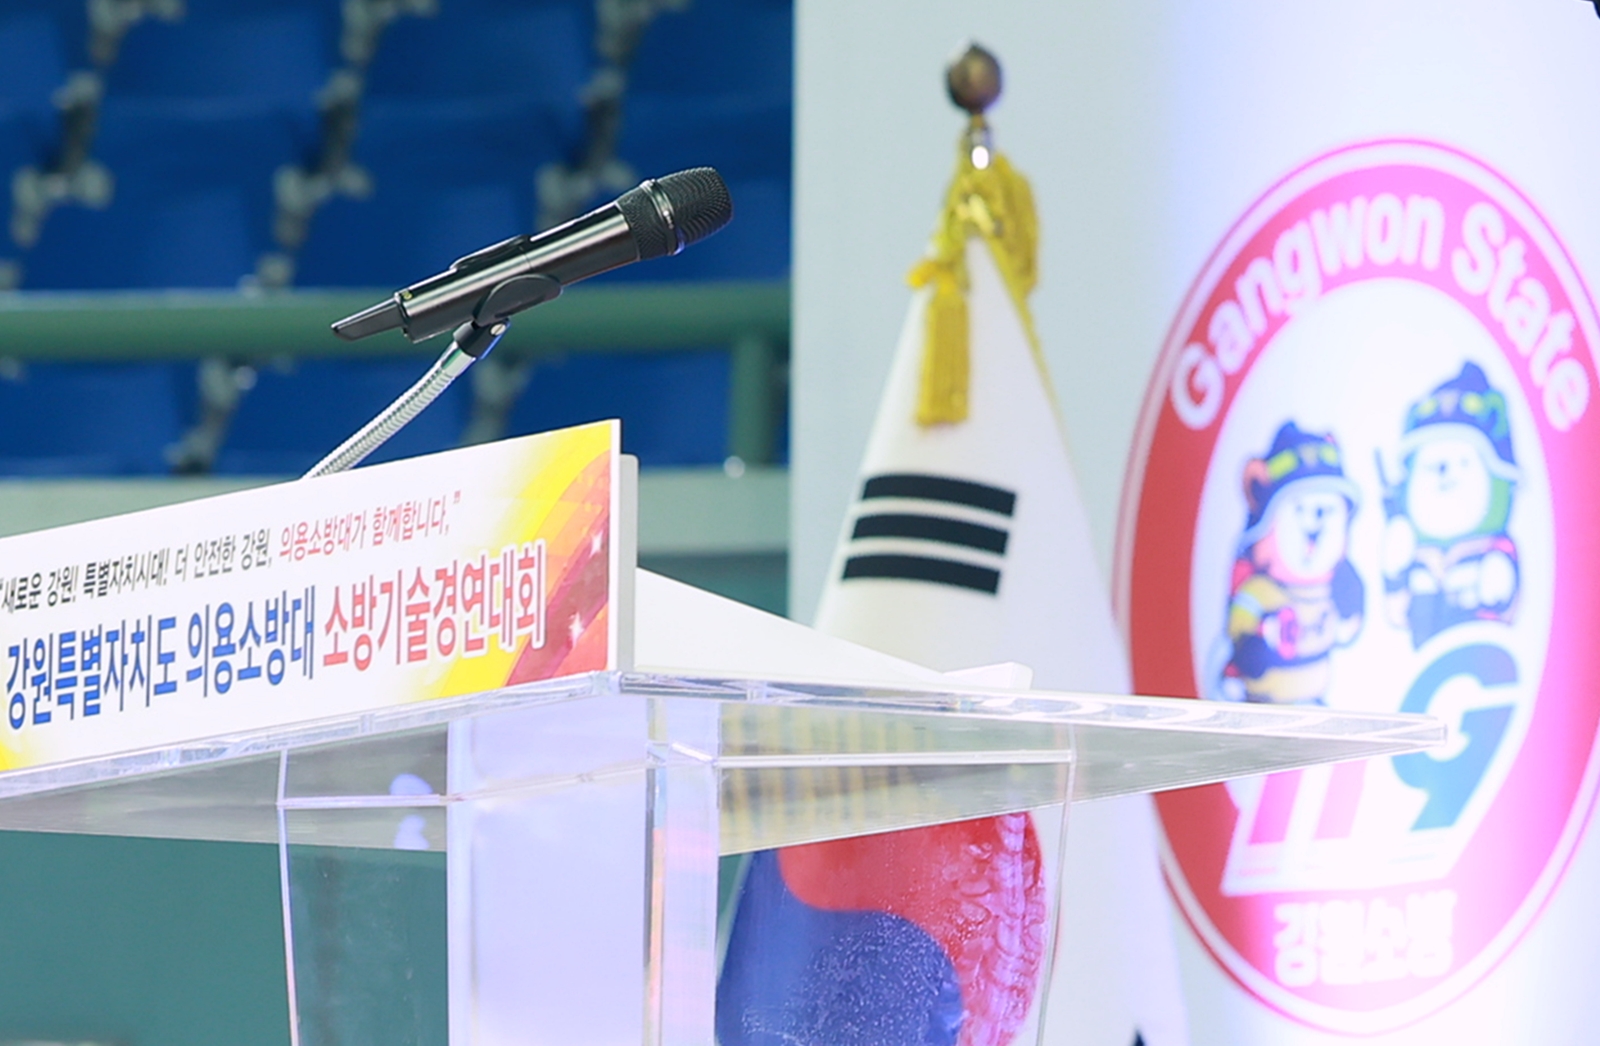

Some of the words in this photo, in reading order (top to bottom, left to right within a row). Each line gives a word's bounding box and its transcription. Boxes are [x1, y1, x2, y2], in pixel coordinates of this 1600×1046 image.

[1170, 193, 1446, 431] Gangwon
[1451, 201, 1591, 432] State
[6, 615, 177, 730] 강원특별자치도
[186, 585, 315, 698] 의용소방대
[323, 545, 545, 672] 소방기술경연대회
[47, 565, 79, 607] 강원!
[83, 548, 170, 599] 특별자치시대!
[175, 543, 189, 582] 더
[194, 534, 236, 579] 안전한
[279, 509, 366, 562] 의용소방대가
